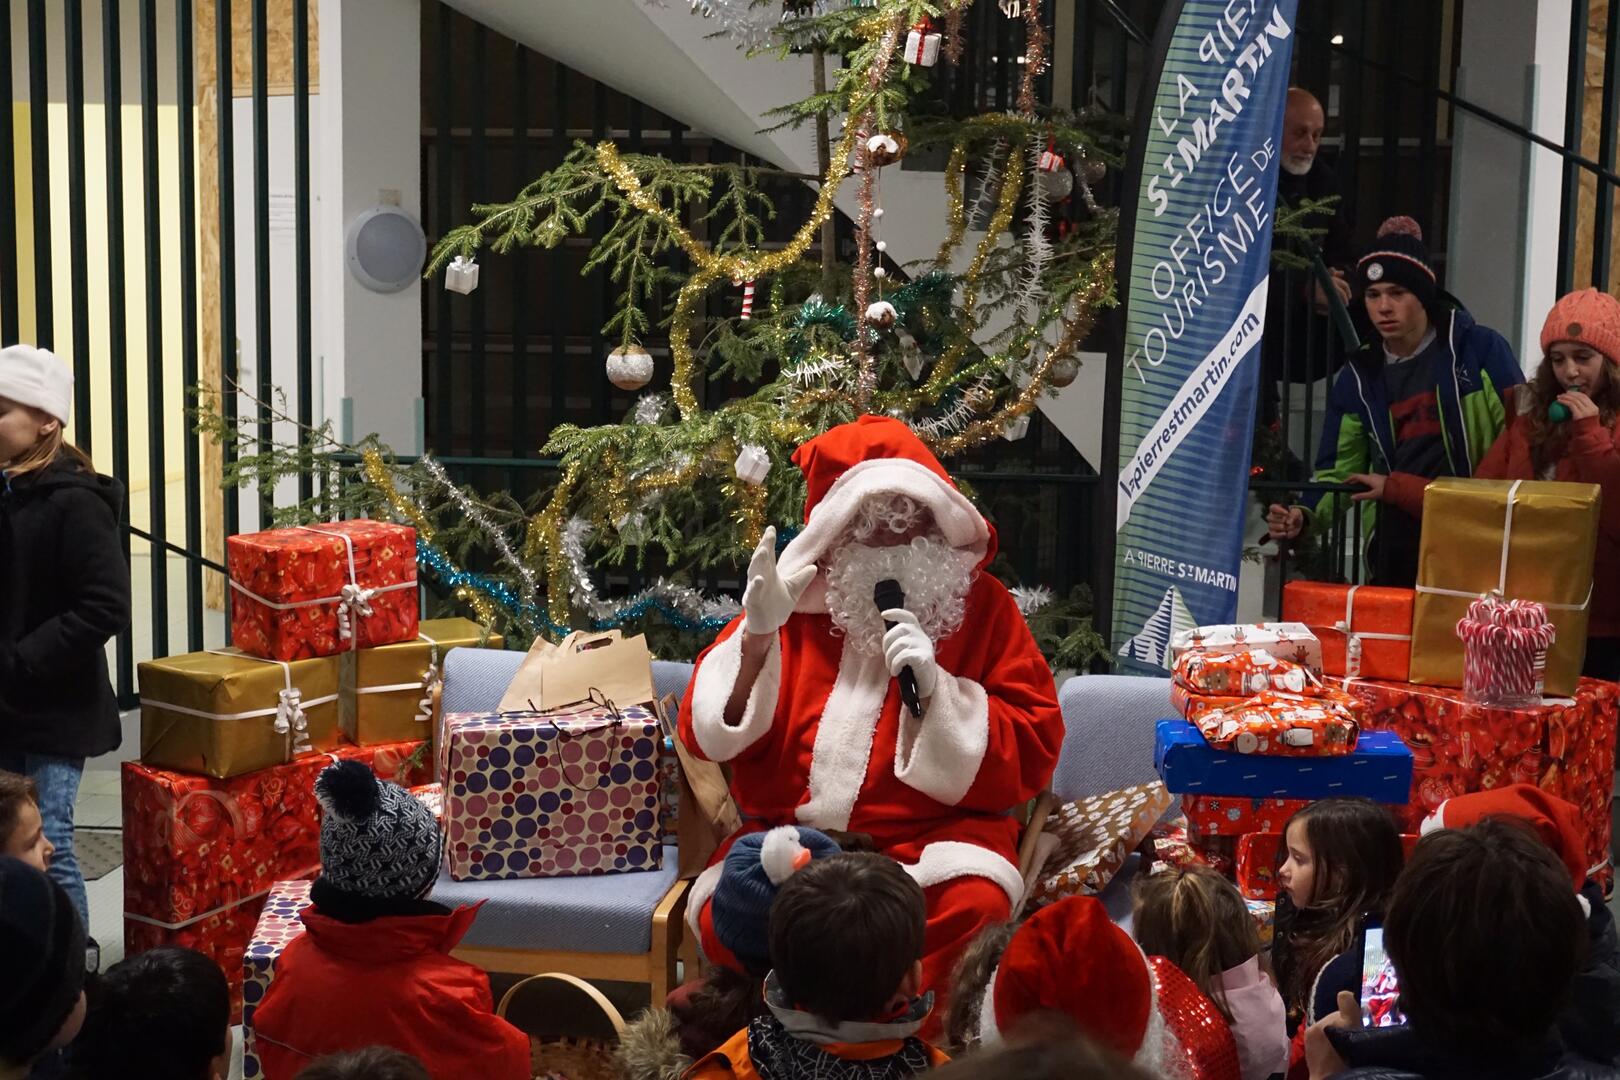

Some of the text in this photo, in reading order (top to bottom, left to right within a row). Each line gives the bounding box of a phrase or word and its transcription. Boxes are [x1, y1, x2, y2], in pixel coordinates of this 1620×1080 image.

[1157, 0, 1256, 137] LA PIE
[1126, 188, 1269, 385] TOURISME
[1151, 137, 1275, 300] OFFICE DE
[1137, 551, 1176, 576] PIERRE
